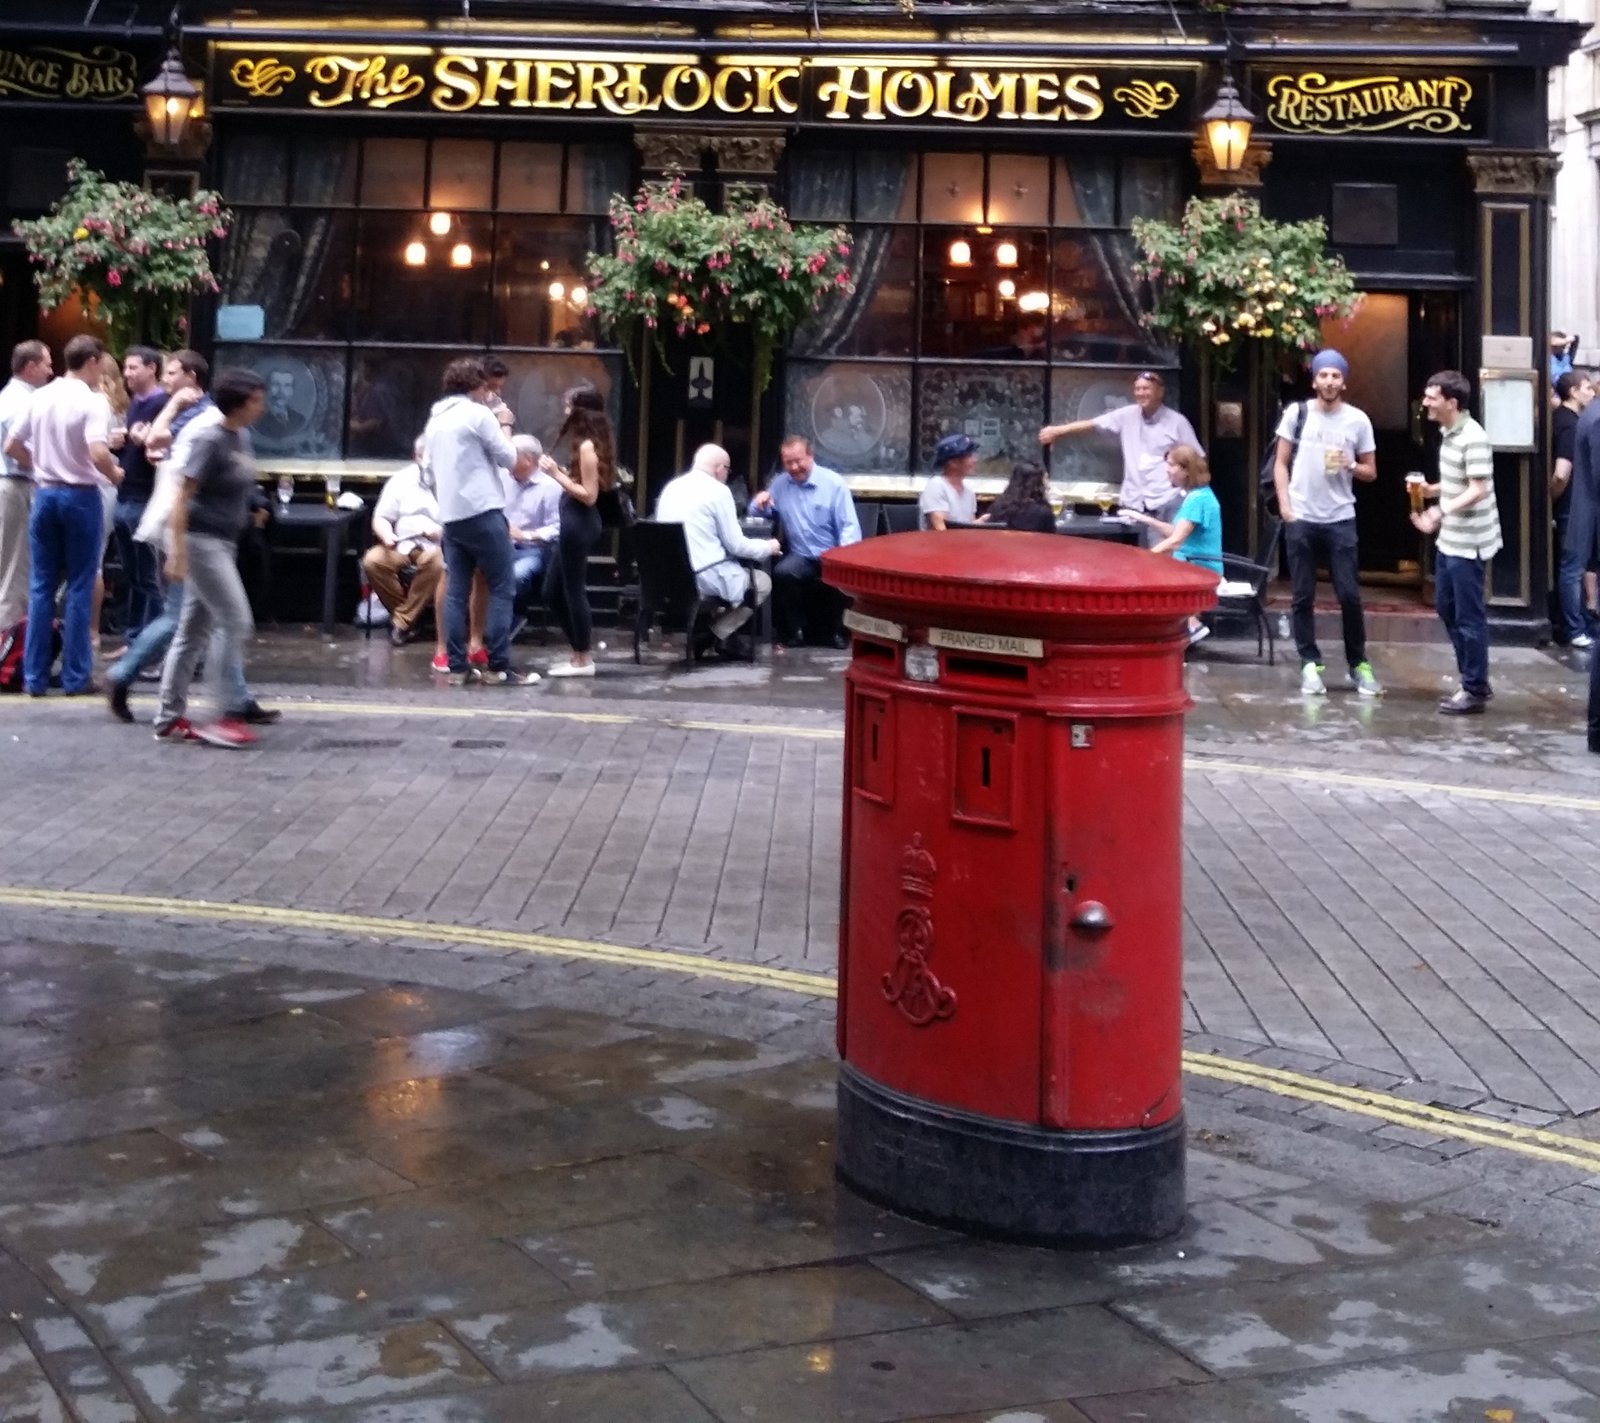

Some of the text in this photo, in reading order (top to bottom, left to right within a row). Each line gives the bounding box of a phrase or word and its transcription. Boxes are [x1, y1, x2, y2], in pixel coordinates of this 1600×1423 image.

[66, 62, 128, 97] BAR
[304, 55, 1104, 122] The SHERLOCK HOLMES
[1275, 79, 1459, 126] RESTAURANT
[940, 631, 1029, 654] FRANKED MAIL
[1038, 665, 1122, 690] OFFICE
